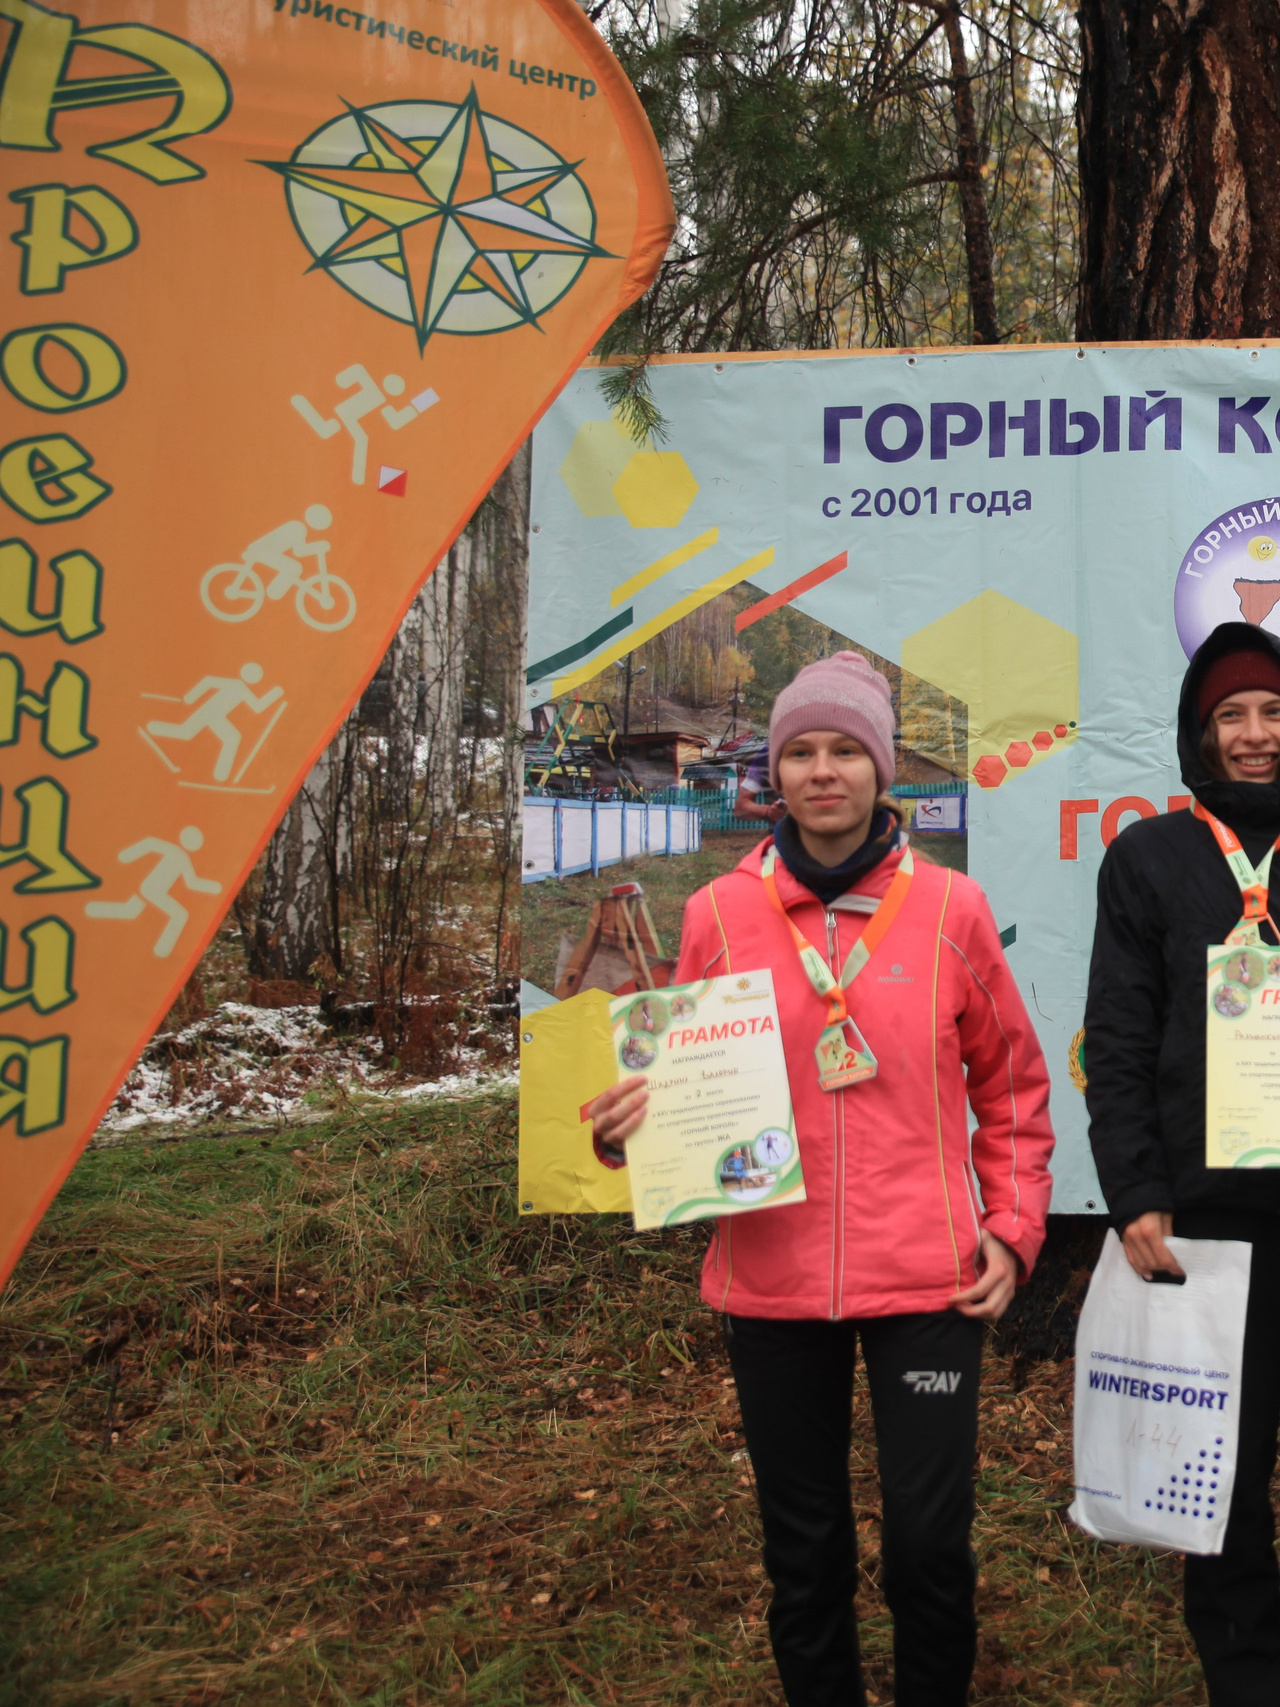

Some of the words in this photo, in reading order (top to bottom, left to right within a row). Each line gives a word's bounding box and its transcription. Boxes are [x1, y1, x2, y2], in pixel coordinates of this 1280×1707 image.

[508, 58, 598, 101] центр
[823, 390, 1182, 464] ГОРНЫЙ
[821, 496, 842, 518] с
[850, 486, 938, 518] 2001
[949, 489, 1033, 517] года
[668, 1015, 776, 1049] ГРАМОТА
[672, 1050, 727, 1065] НАГРАЖДАЕТСЯ
[844, 1051, 858, 1069] 2
[696, 1089, 703, 1098] 2
[1088, 1369, 1229, 1411] WINTERSPORT
[1204, 1369, 1230, 1380] ЦЕНТР
